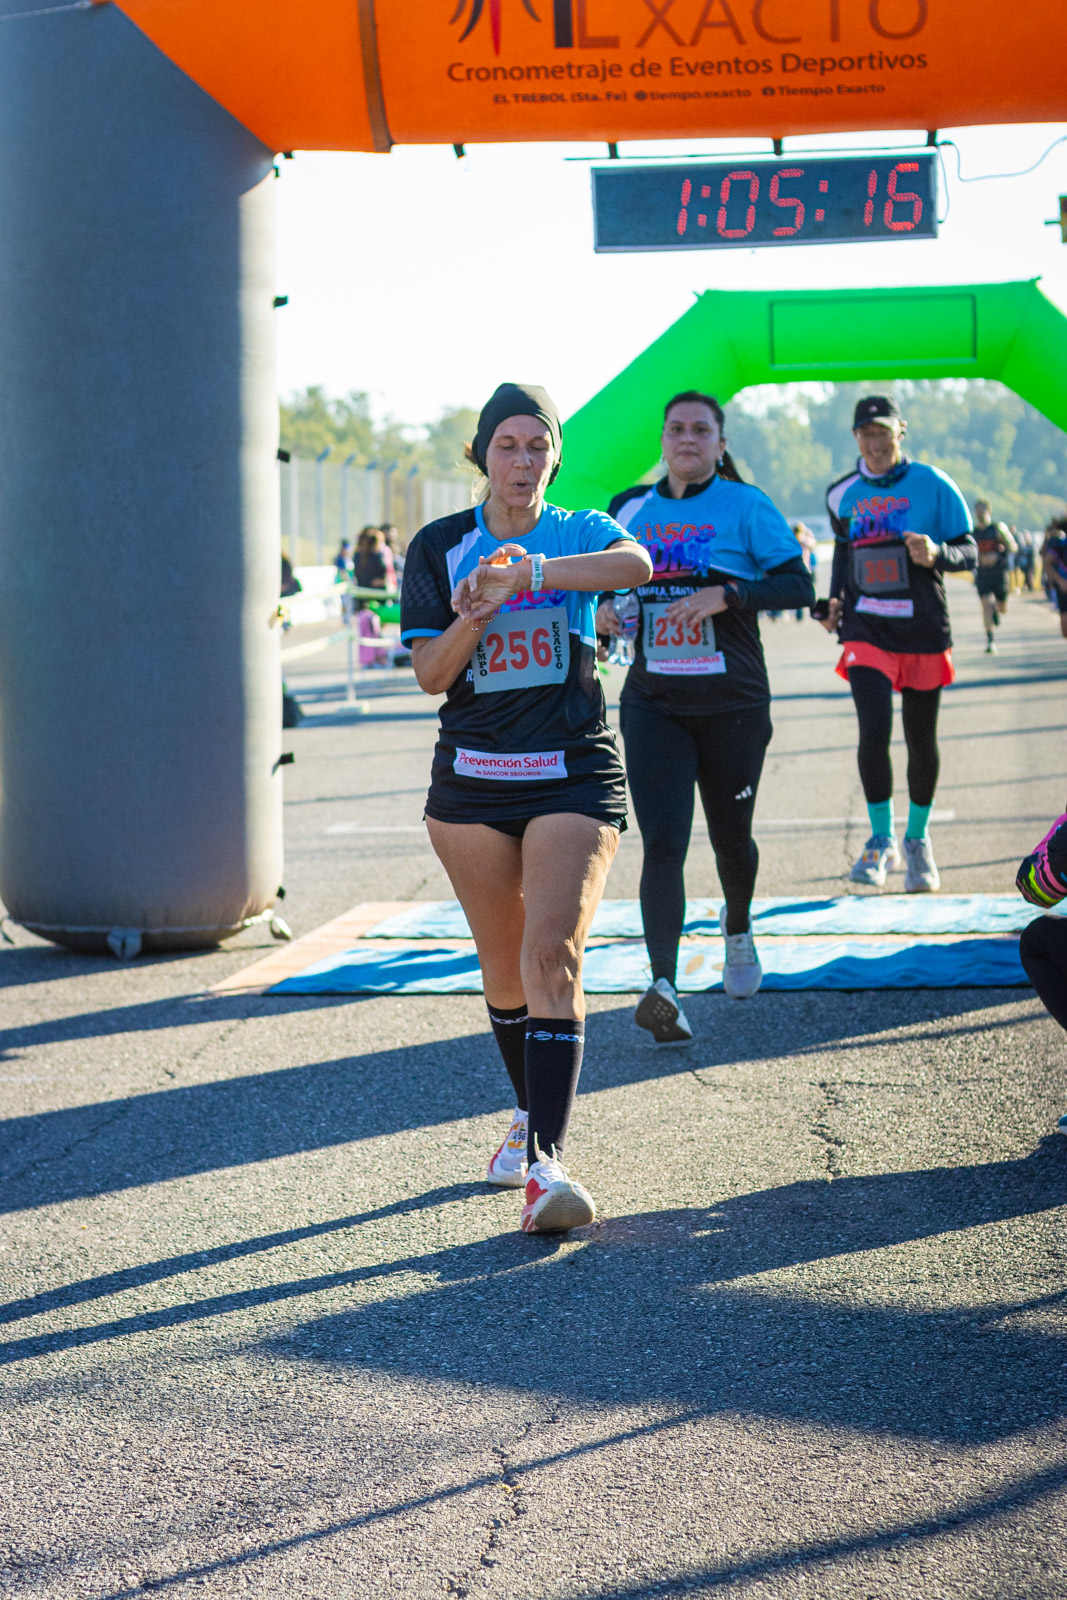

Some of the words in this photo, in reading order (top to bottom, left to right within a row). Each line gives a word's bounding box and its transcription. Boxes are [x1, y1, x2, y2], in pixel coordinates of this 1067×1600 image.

[447, 59, 623, 82] Cronometraje
[630, 57, 663, 77] de
[670, 55, 773, 77] Eventos
[781, 50, 928, 76] Deportivos
[493, 94, 509, 103] EL
[512, 92, 566, 103] TREBOL
[605, 90, 628, 102] Fe)
[777, 85, 834, 97] Tiempo
[837, 83, 885, 95] Exacto
[551, 621, 563, 670] EXACTO
[655, 616, 702, 647] 233
[476, 640, 488, 677] EMPO
[485, 627, 553, 673] 256
[458, 752, 522, 768] Prevención
[523, 754, 558, 769] Salud
